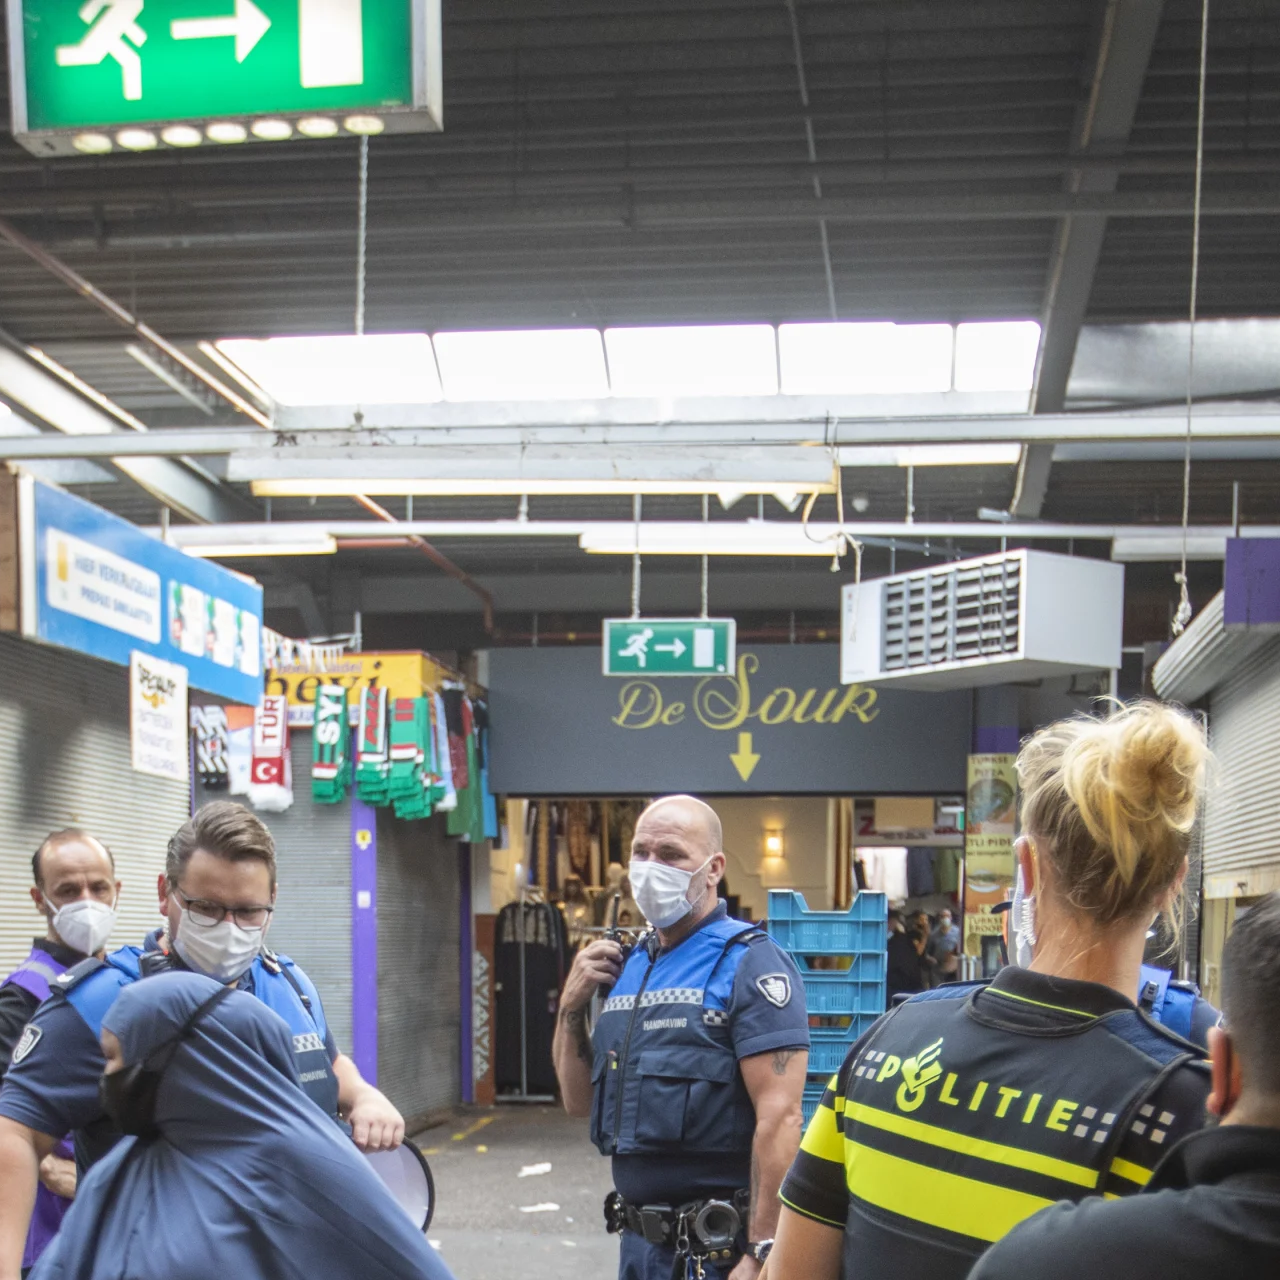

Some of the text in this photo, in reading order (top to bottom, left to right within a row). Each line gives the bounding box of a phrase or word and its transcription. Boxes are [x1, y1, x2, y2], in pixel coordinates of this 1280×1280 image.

[611, 653, 882, 731] De Souk
[642, 1016, 688, 1033] HANDHAVING
[876, 1046, 1080, 1132] POLITIE
